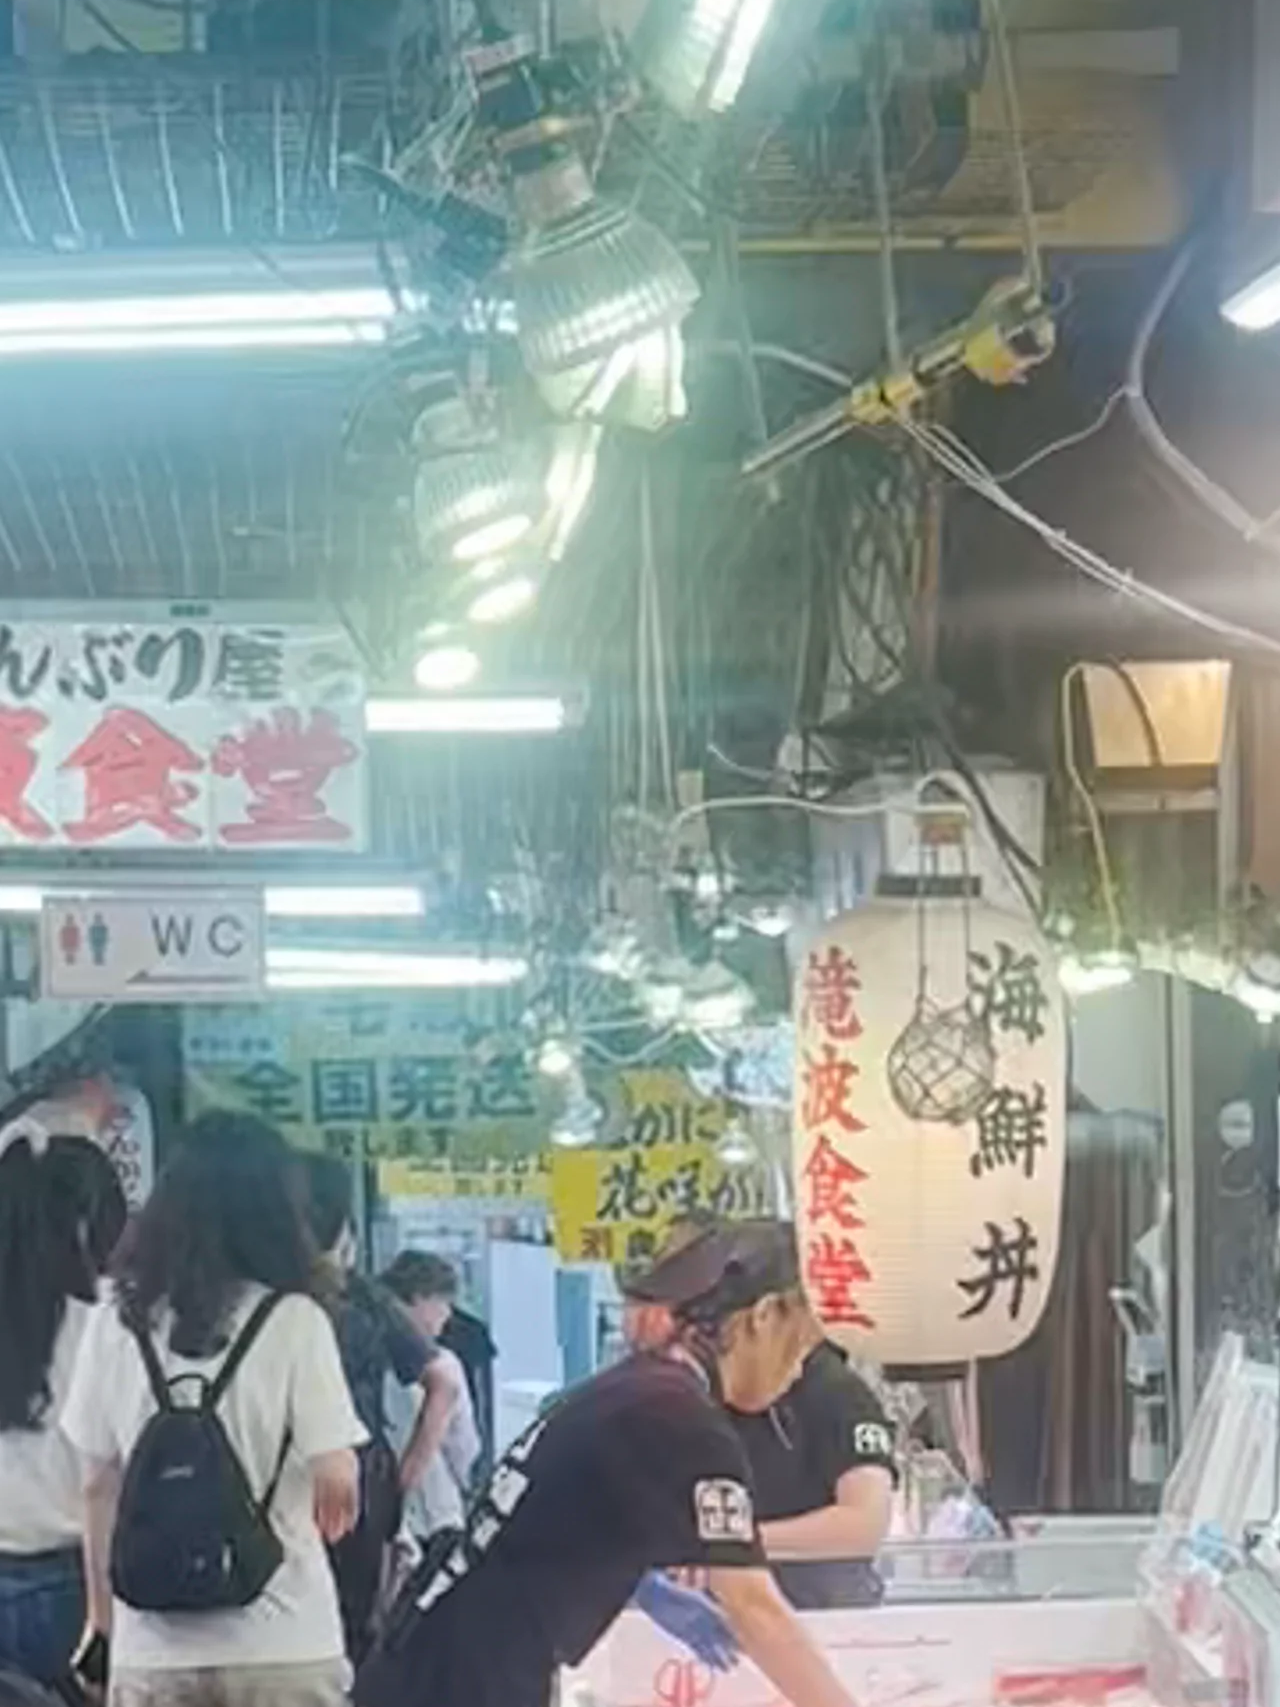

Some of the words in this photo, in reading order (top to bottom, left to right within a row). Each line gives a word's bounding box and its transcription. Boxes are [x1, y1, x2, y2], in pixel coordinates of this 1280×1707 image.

[151, 914, 245, 958] WC
[231, 1055, 538, 1124] 全国発送
